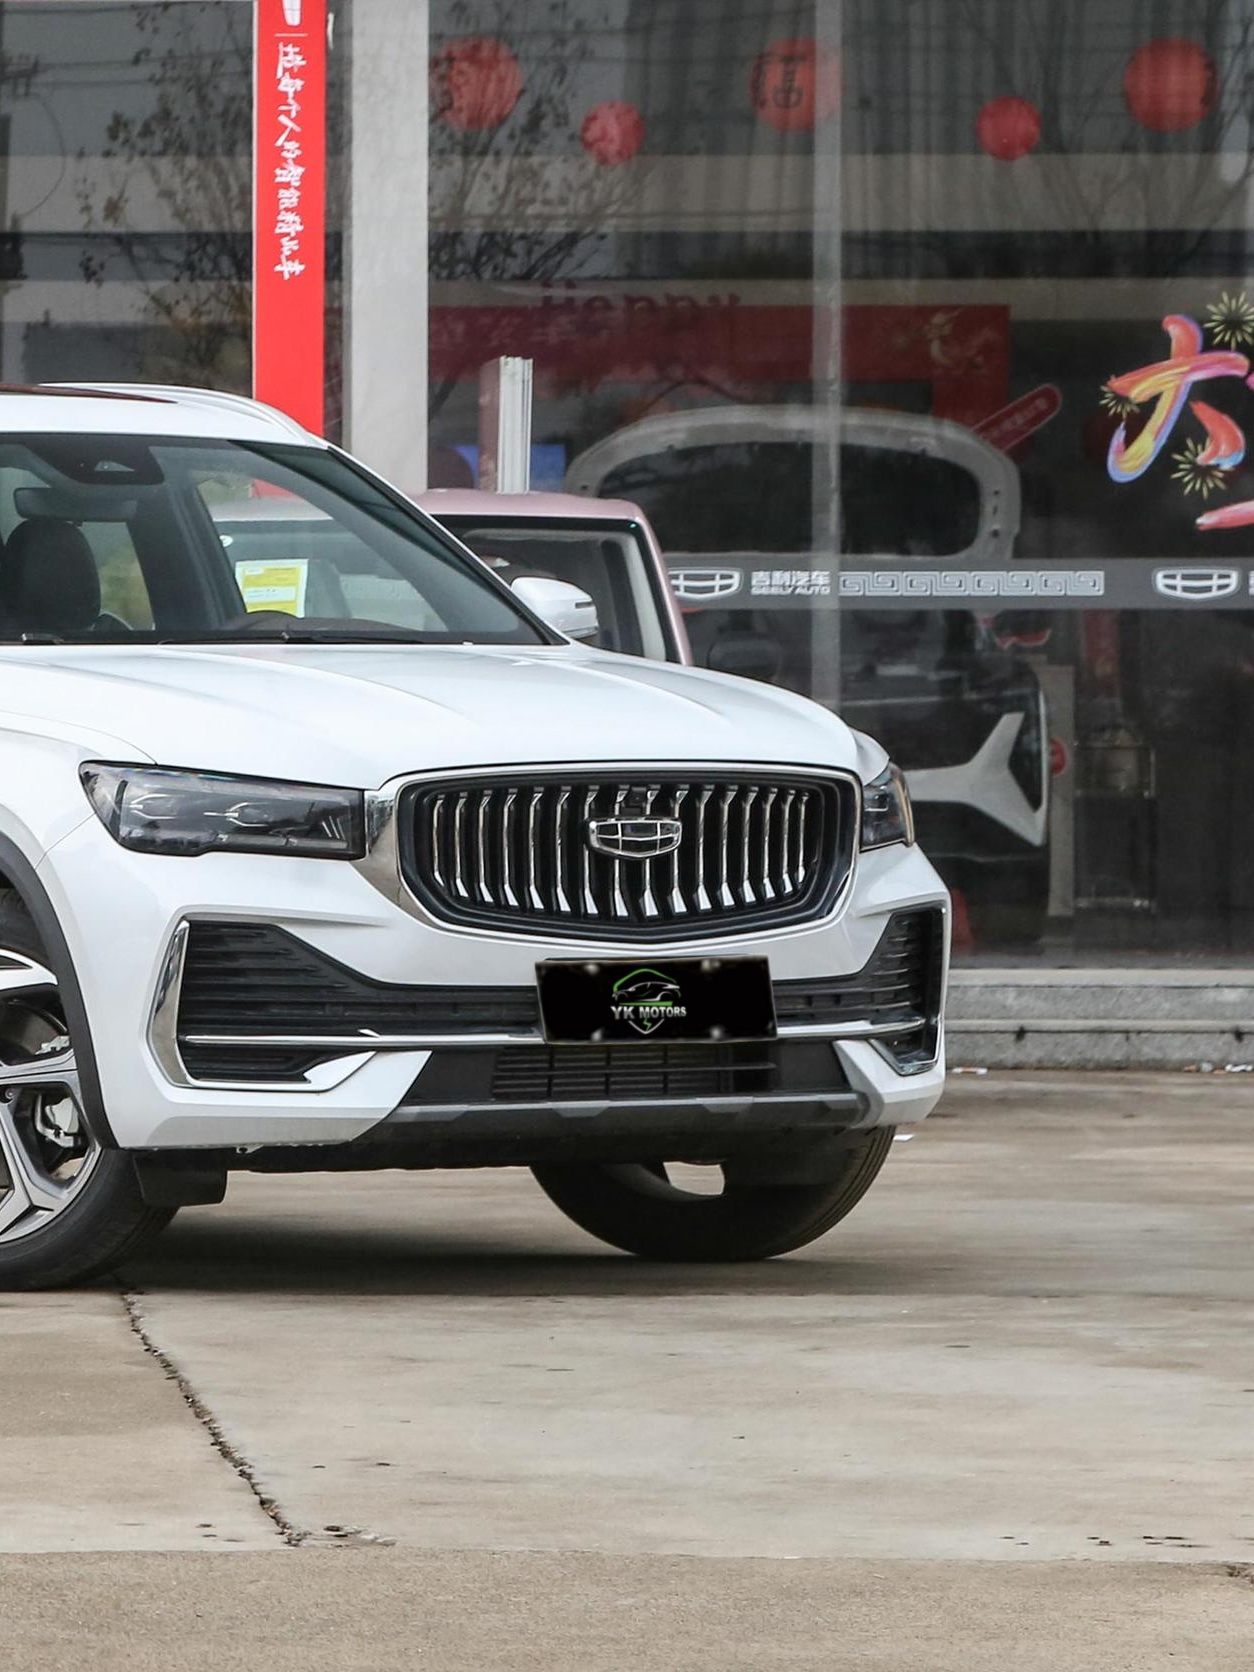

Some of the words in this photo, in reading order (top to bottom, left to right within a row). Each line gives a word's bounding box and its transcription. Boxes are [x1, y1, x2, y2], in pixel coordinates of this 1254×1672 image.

[751, 570, 830, 586] 吉利汽车
[794, 586, 831, 596] AUTO
